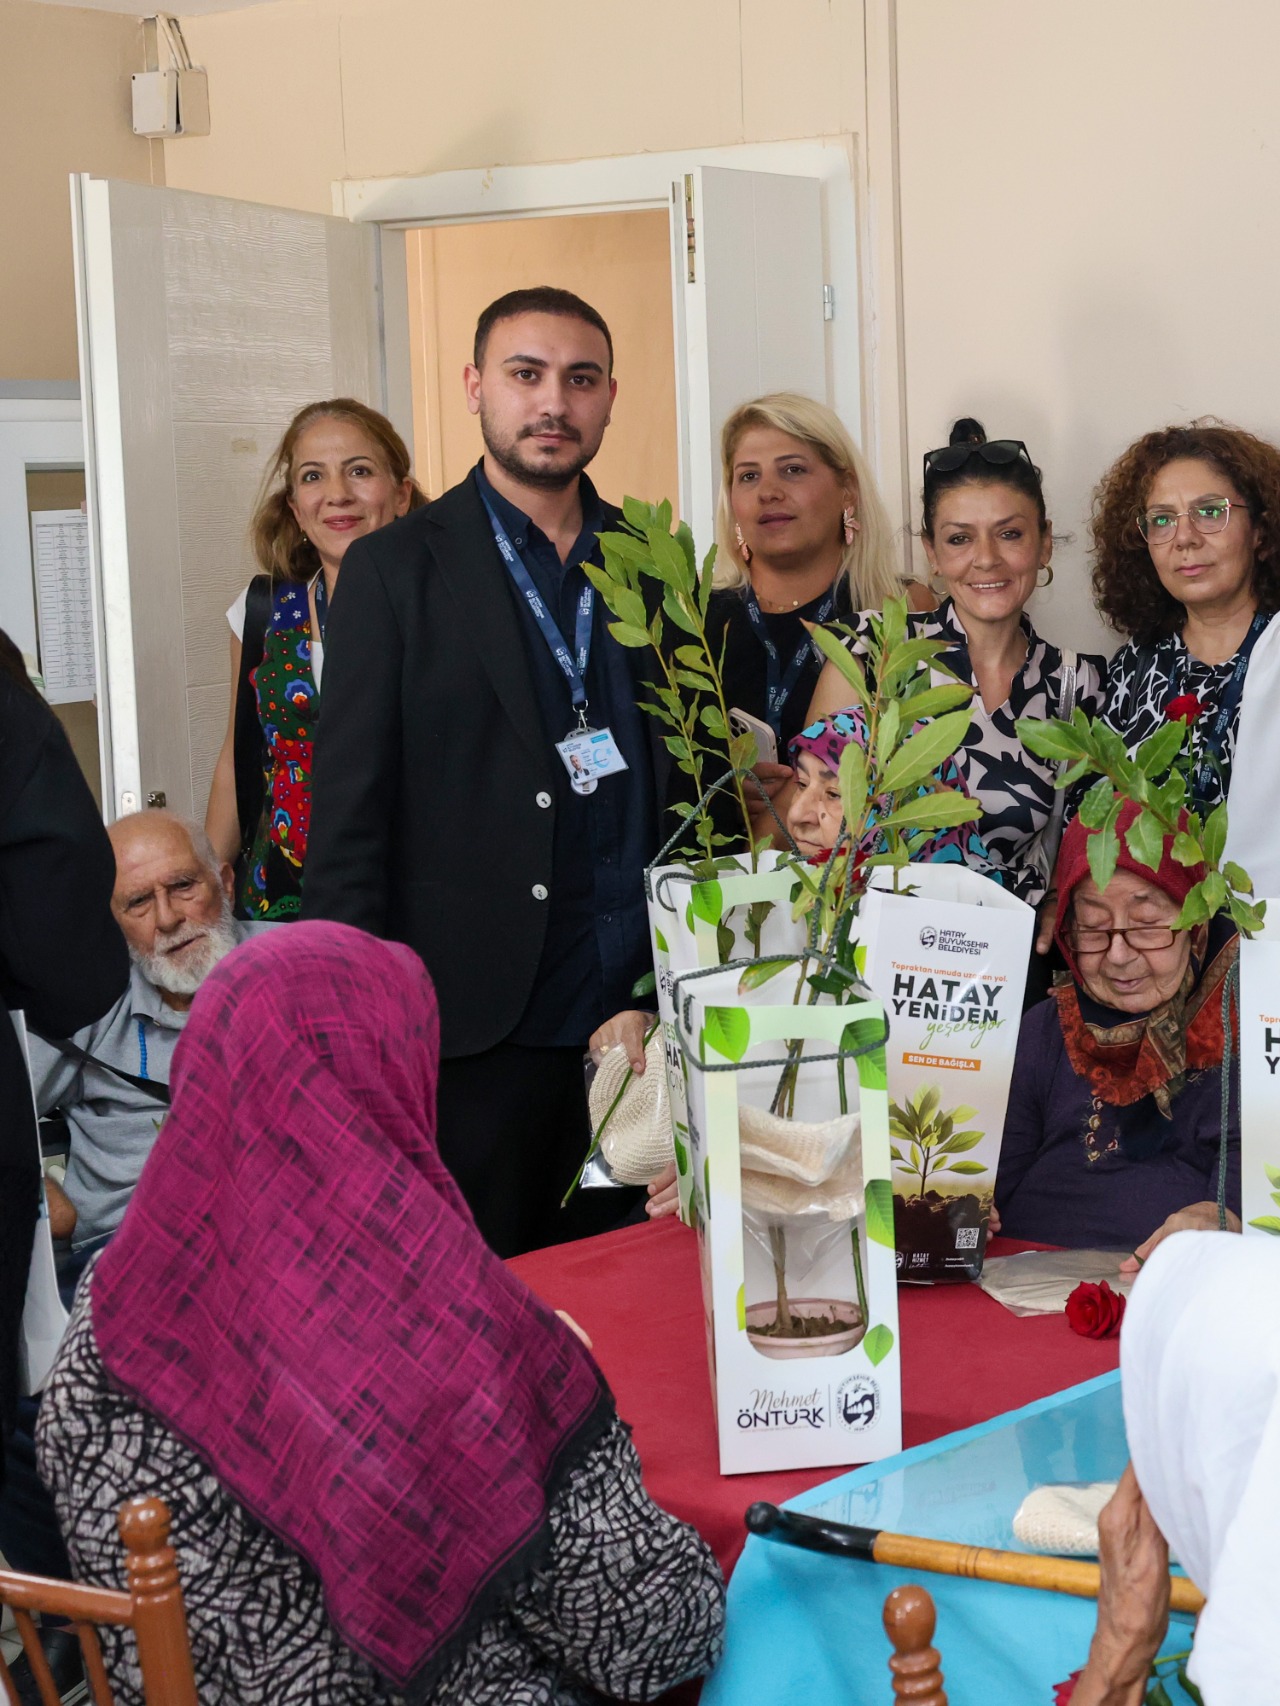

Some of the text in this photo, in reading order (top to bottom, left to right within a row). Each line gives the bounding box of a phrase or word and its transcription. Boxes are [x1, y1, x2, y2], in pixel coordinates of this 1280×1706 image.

[940, 929, 966, 938] HATAY
[891, 961, 1008, 983] Topraktan umuda uzaan yol.
[893, 973, 1003, 1007] HATAY
[908, 1055, 975, 1069] SEN DE BAĞIŞLA
[750, 1388, 822, 1411] Mehmet
[737, 1407, 825, 1429] ÖNTÜRK
